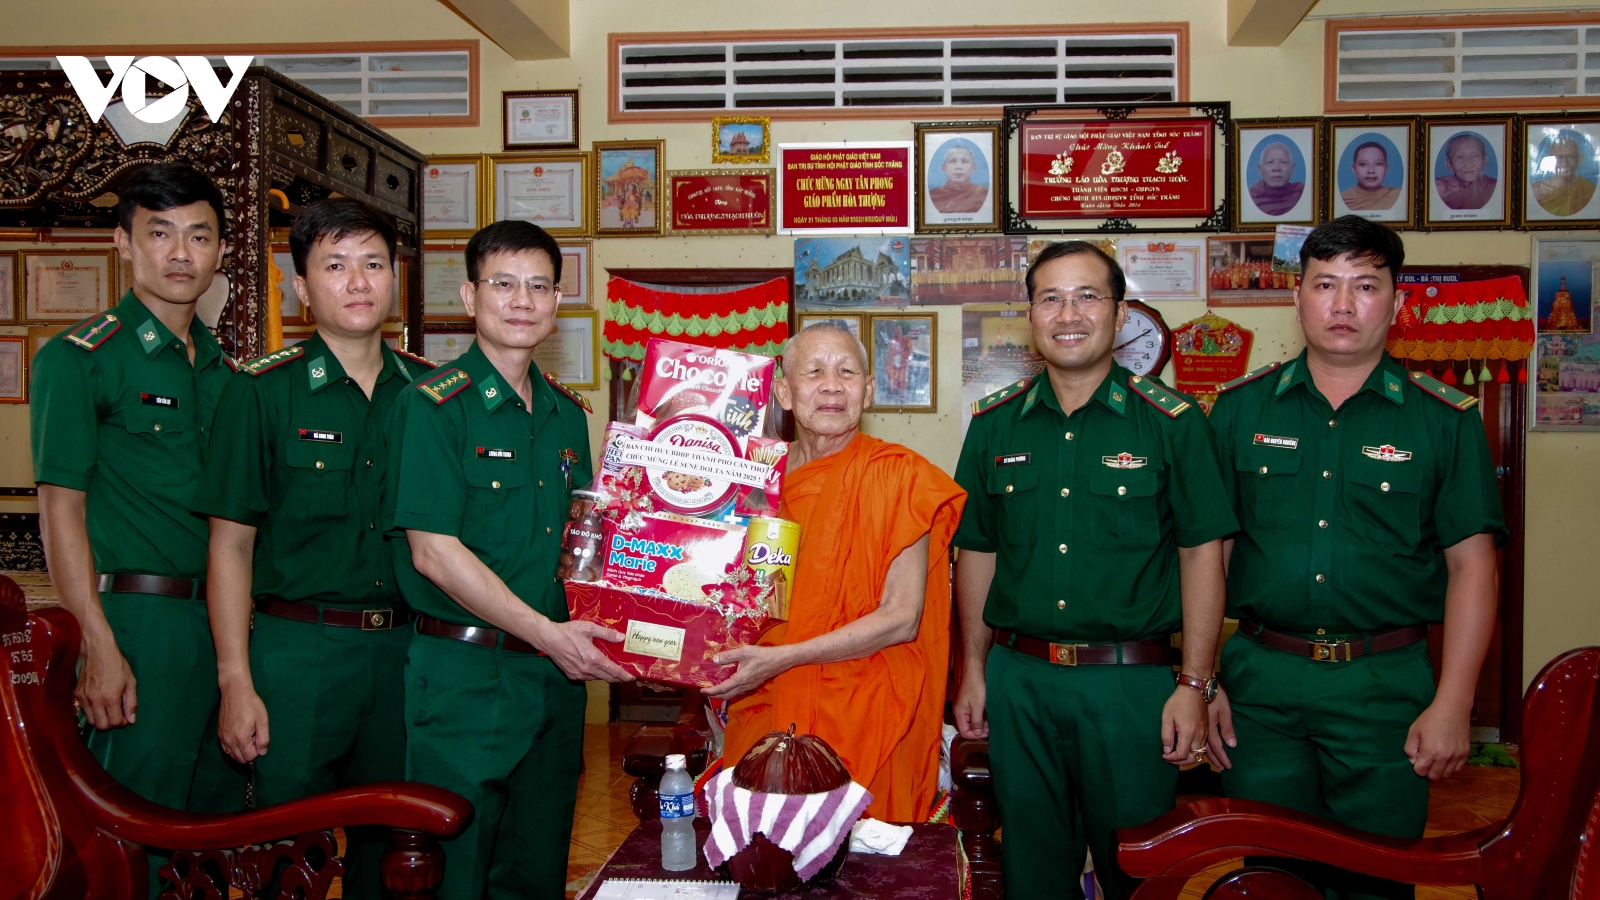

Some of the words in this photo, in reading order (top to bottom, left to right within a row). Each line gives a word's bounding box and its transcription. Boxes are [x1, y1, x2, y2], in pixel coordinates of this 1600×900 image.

[810, 152, 822, 160] GIÁO
[846, 152, 858, 160] GIÁO
[796, 176, 814, 190] CHÚC
[815, 176, 834, 190] MỪNG
[870, 177, 893, 189] PHONG
[804, 193, 820, 208] GIÁO
[843, 192, 857, 207] HÒA
[858, 192, 885, 210] THƯỢNG
[794, 215, 807, 223] NGÀY
[815, 215, 831, 223] THÁNG
[698, 355, 728, 369] ORIO
[655, 357, 761, 393] Chocoie
[669, 433, 722, 453] Danisa
[625, 443, 639, 451] BAN
[654, 447, 668, 455] HUY
[692, 453, 716, 463] THÀNH
[625, 452, 645, 461] CHÚC
[680, 461, 698, 471] SENE
[700, 464, 724, 475] DOLTA
[726, 468, 742, 478] NĂM
[743, 473, 757, 482] 2025
[570, 528, 580, 536] TÁO
[612, 534, 684, 560] D-MAXX
[748, 542, 792, 566] Deka
[631, 631, 652, 645] Happy
[652, 636, 664, 645] new
[664, 638, 678, 648] year
